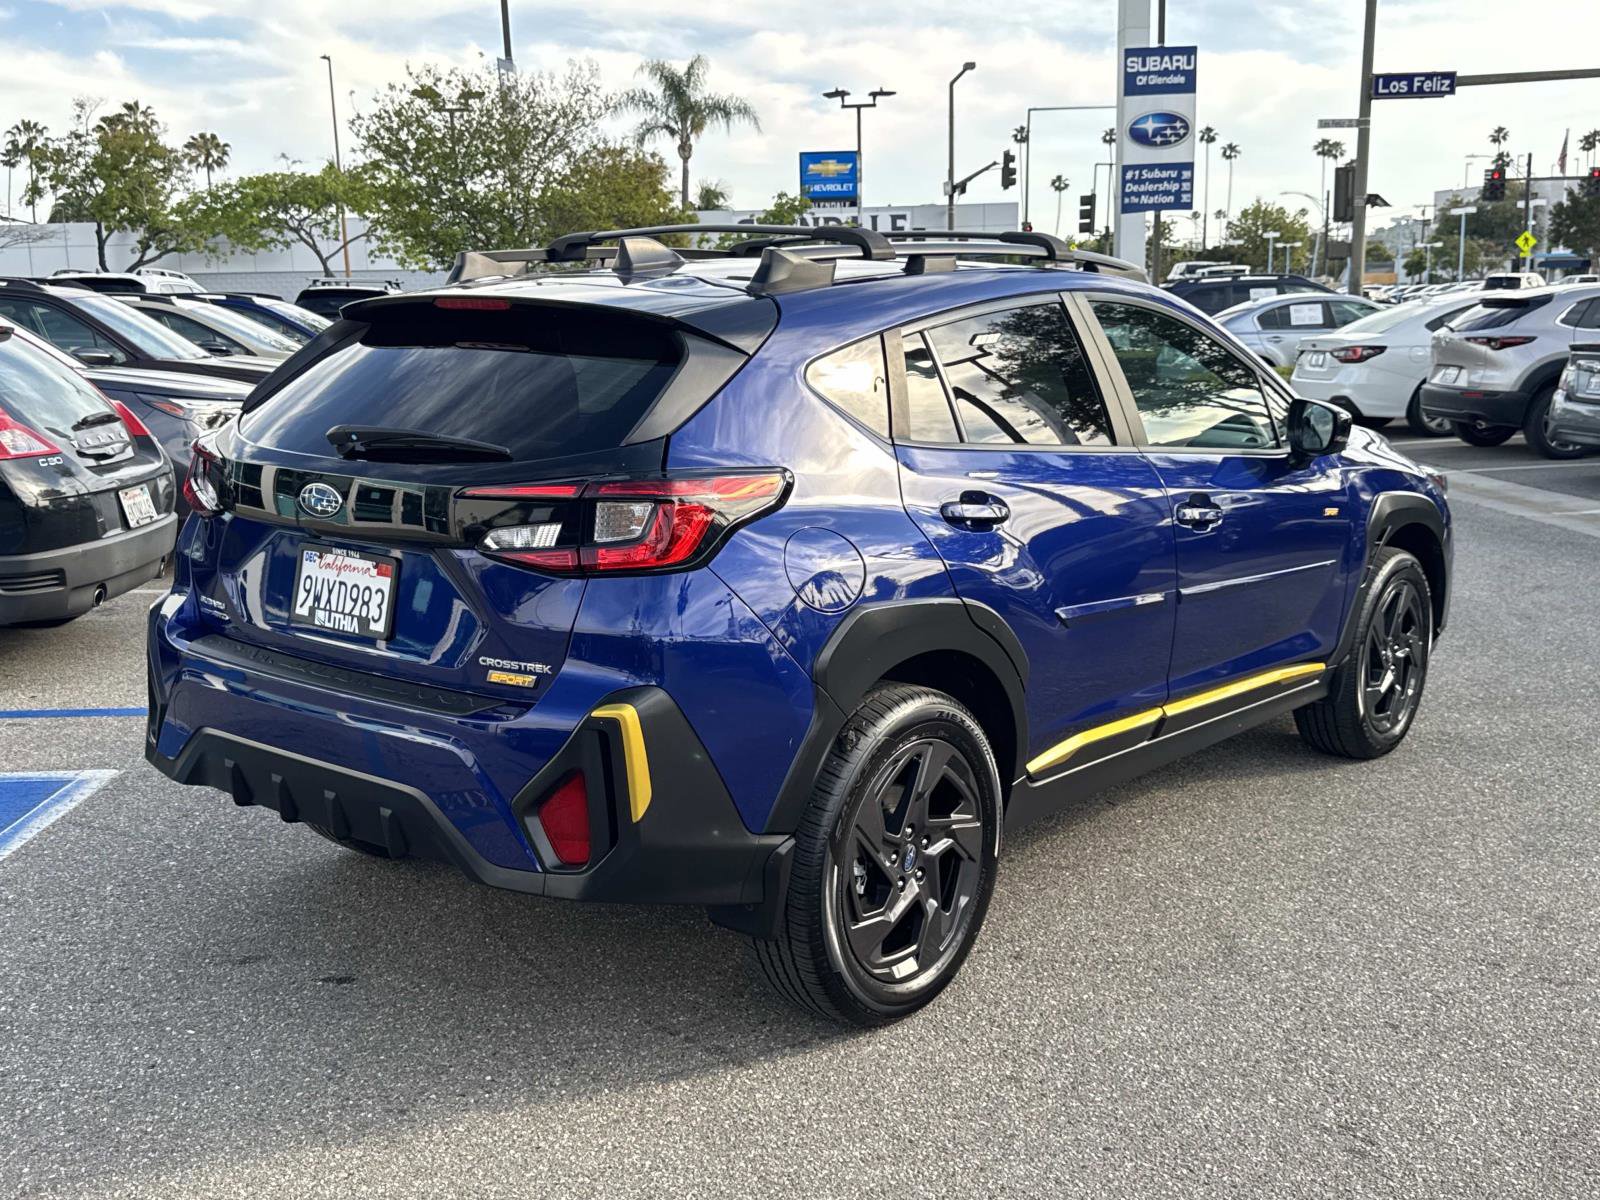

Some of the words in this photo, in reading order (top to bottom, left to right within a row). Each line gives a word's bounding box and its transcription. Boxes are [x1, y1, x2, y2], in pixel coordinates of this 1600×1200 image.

[1126, 55, 1195, 73] SUBARU
[1136, 75, 1147, 86] Of
[1148, 74, 1186, 85] Glendale
[1378, 77, 1409, 93] Los
[1413, 76, 1451, 92] Feliz
[1125, 170, 1139, 180] #1
[1141, 168, 1178, 179] Subaru
[1125, 181, 1181, 193] Dealership
[1140, 194, 1175, 204] Nation
[38, 456, 64, 467] C30
[305, 551, 317, 563] DEC
[318, 553, 377, 577] California
[300, 574, 386, 623] 9WXD983
[325, 611, 360, 634] LITHIA
[478, 656, 552, 674] CROSSTREK
[490, 673, 533, 686] SPORT
